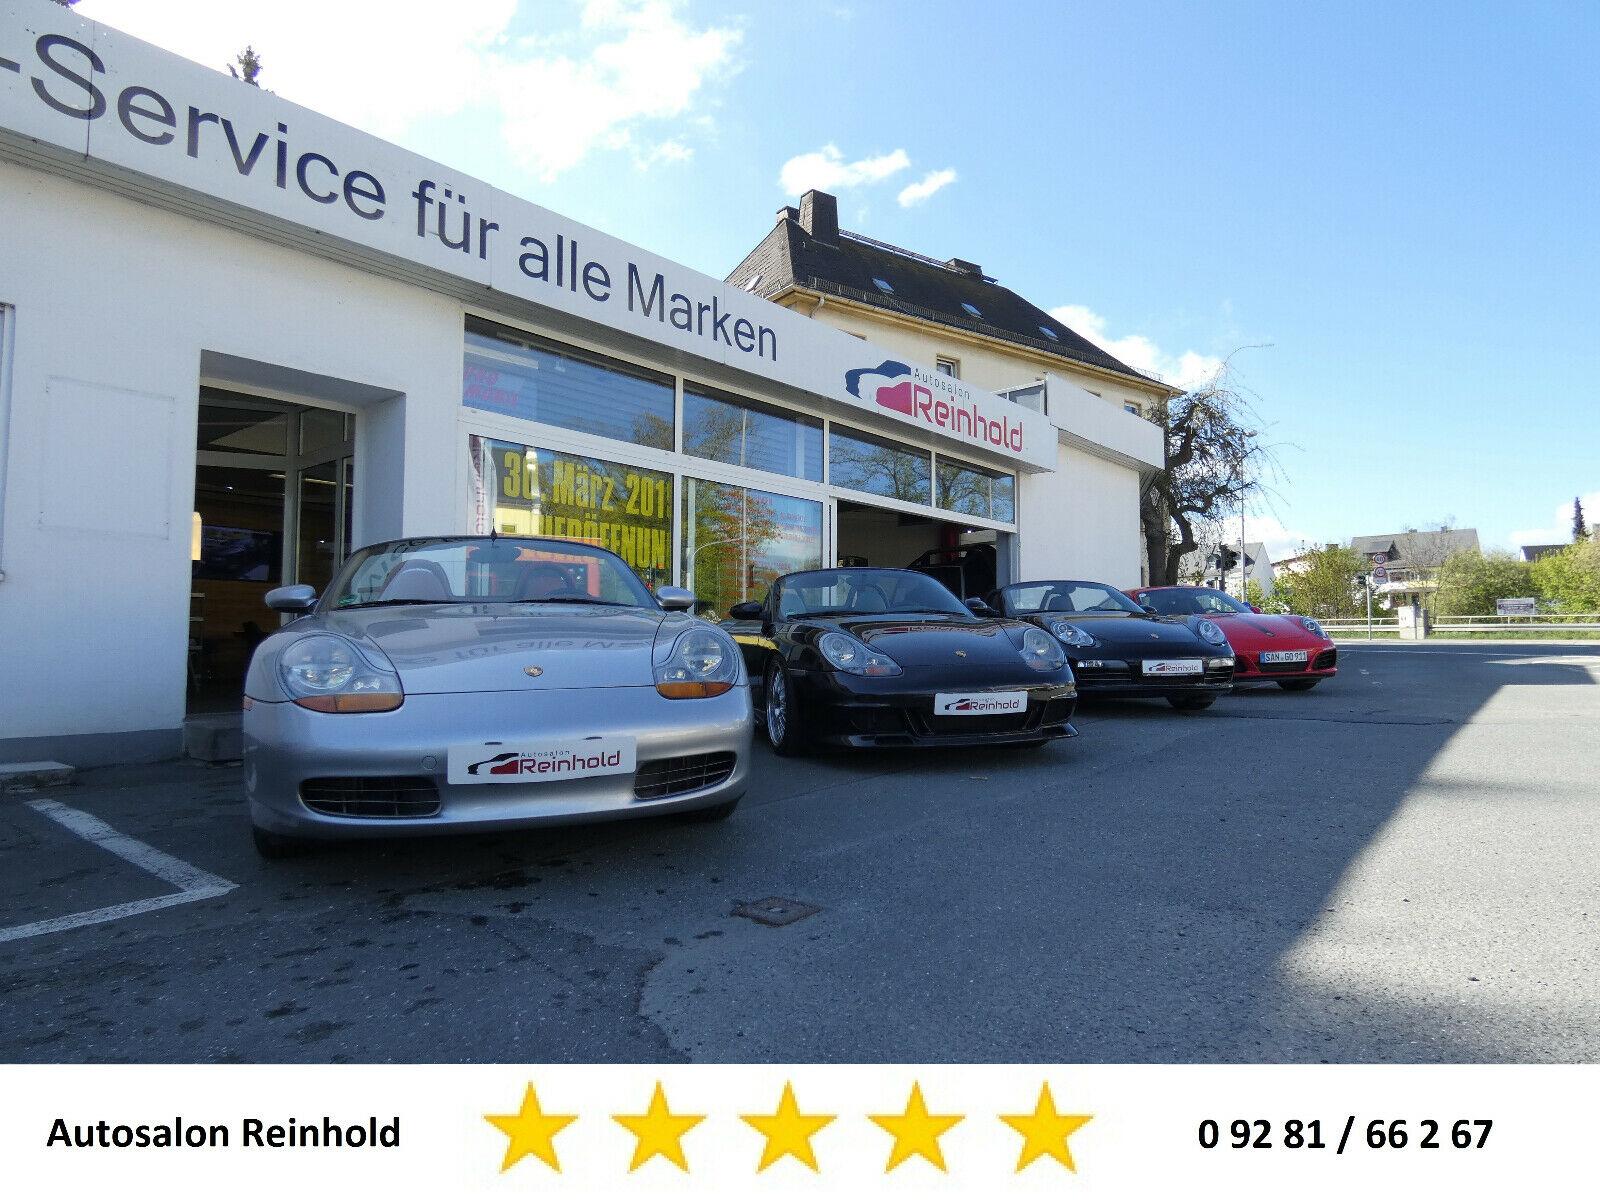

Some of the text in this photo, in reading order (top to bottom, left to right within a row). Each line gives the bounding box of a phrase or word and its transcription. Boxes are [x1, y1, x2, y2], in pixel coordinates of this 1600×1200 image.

[412, 179, 500, 261] für
[518, 234, 611, 302] alle
[627, 262, 777, 362] Marken
[914, 368, 970, 400] Autosalon
[913, 383, 1023, 452] Reinhold
[553, 460, 615, 512] März
[626, 473, 672, 520] 201
[1265, 652, 1280, 662] SAN
[970, 699, 1020, 711] Reinhold
[519, 750, 621, 774] Reinhold
[520, 750, 571, 758] Autosalon
